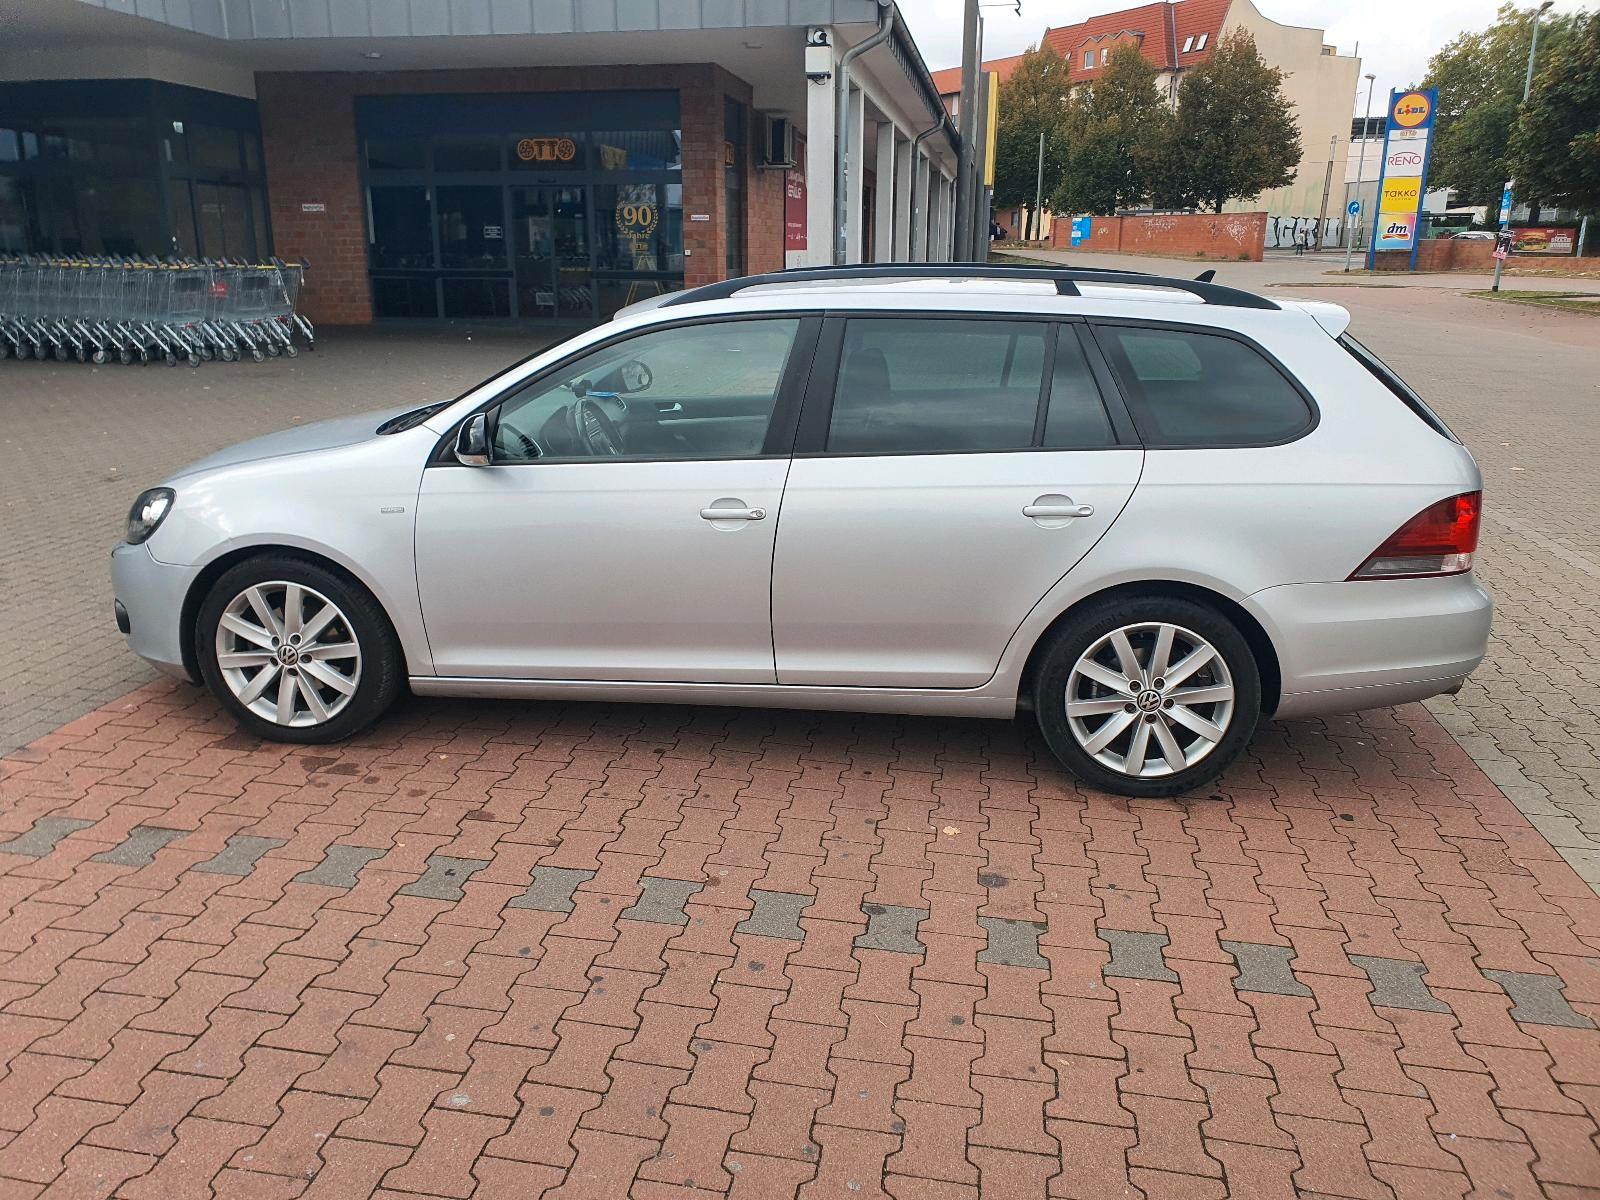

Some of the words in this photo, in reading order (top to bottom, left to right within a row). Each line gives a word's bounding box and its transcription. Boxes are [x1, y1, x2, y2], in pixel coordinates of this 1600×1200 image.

[517, 138, 576, 160] OTTO
[1388, 155, 1421, 165] RENO
[623, 205, 653, 226] 90
[1387, 222, 1407, 233] dm
